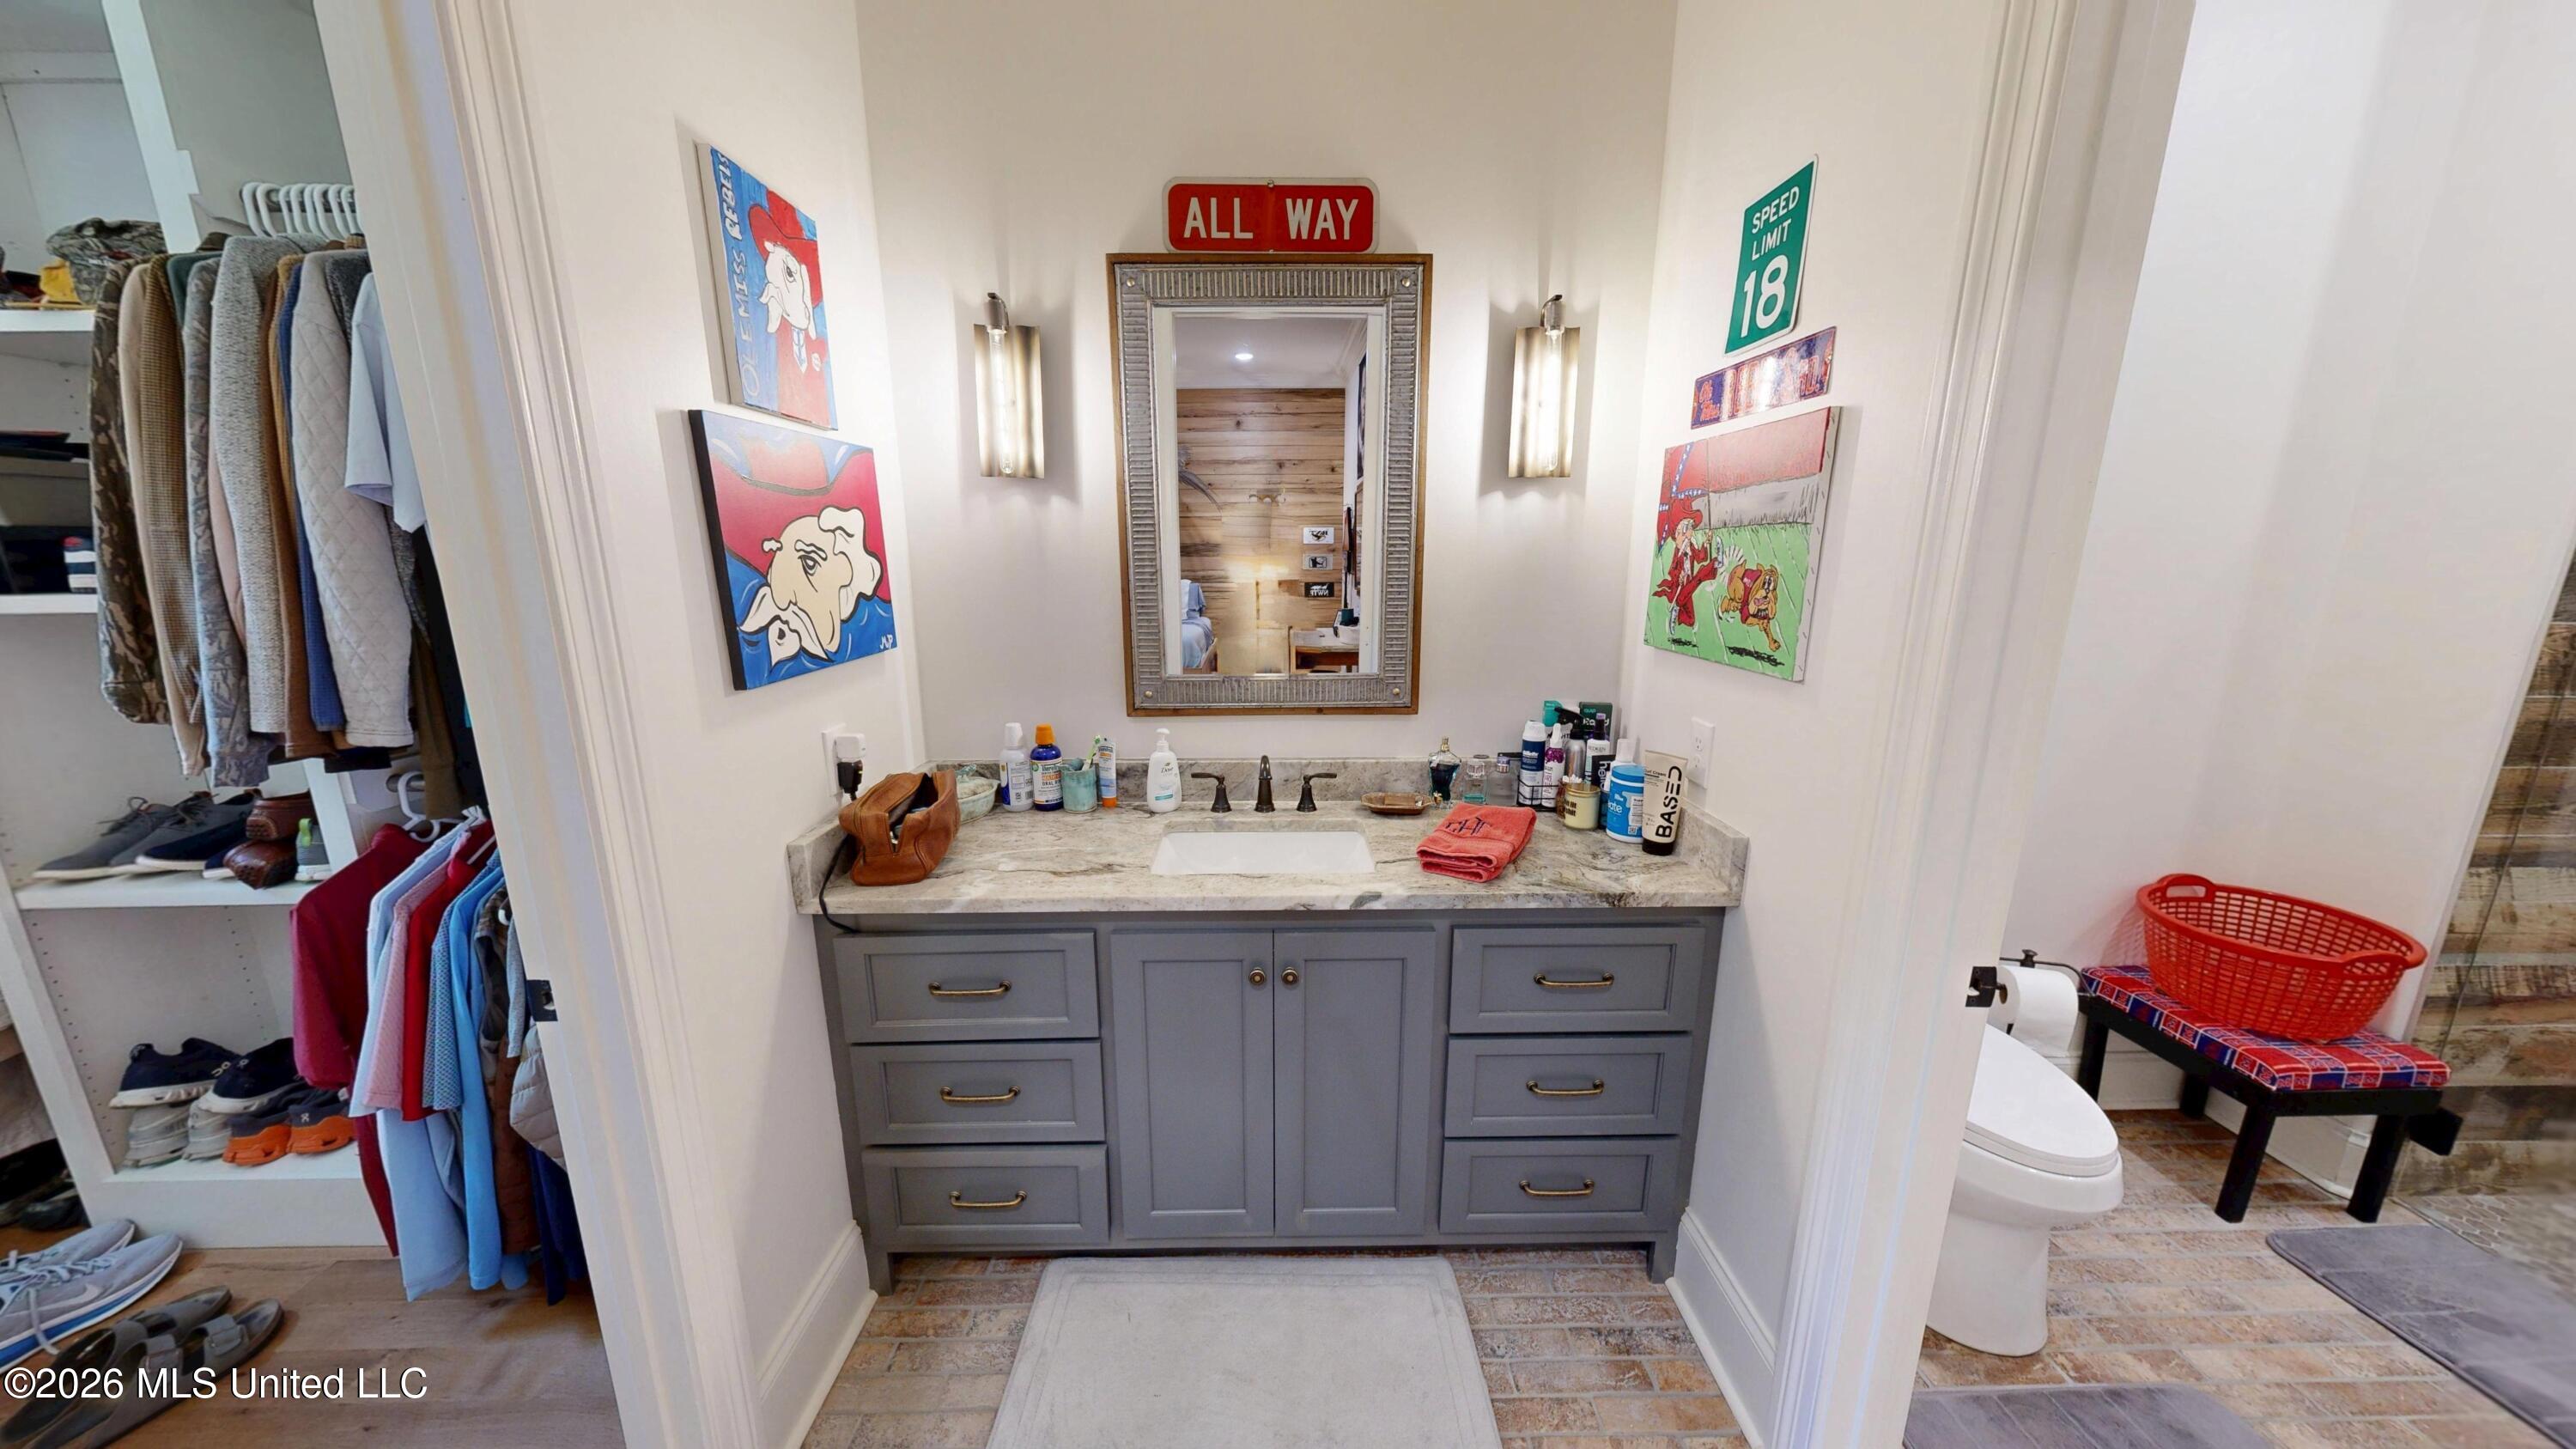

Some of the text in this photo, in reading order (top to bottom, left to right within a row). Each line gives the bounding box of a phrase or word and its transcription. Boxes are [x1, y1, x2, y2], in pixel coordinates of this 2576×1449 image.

[1183, 197, 1359, 240] ALL WAY
[1752, 186, 1800, 234] SPEED
[1752, 218, 1792, 261] LIMIT
[1740, 254, 1789, 338] 18
[1583, 717, 1610, 727] Rad
[1656, 765, 1682, 838] BASED
